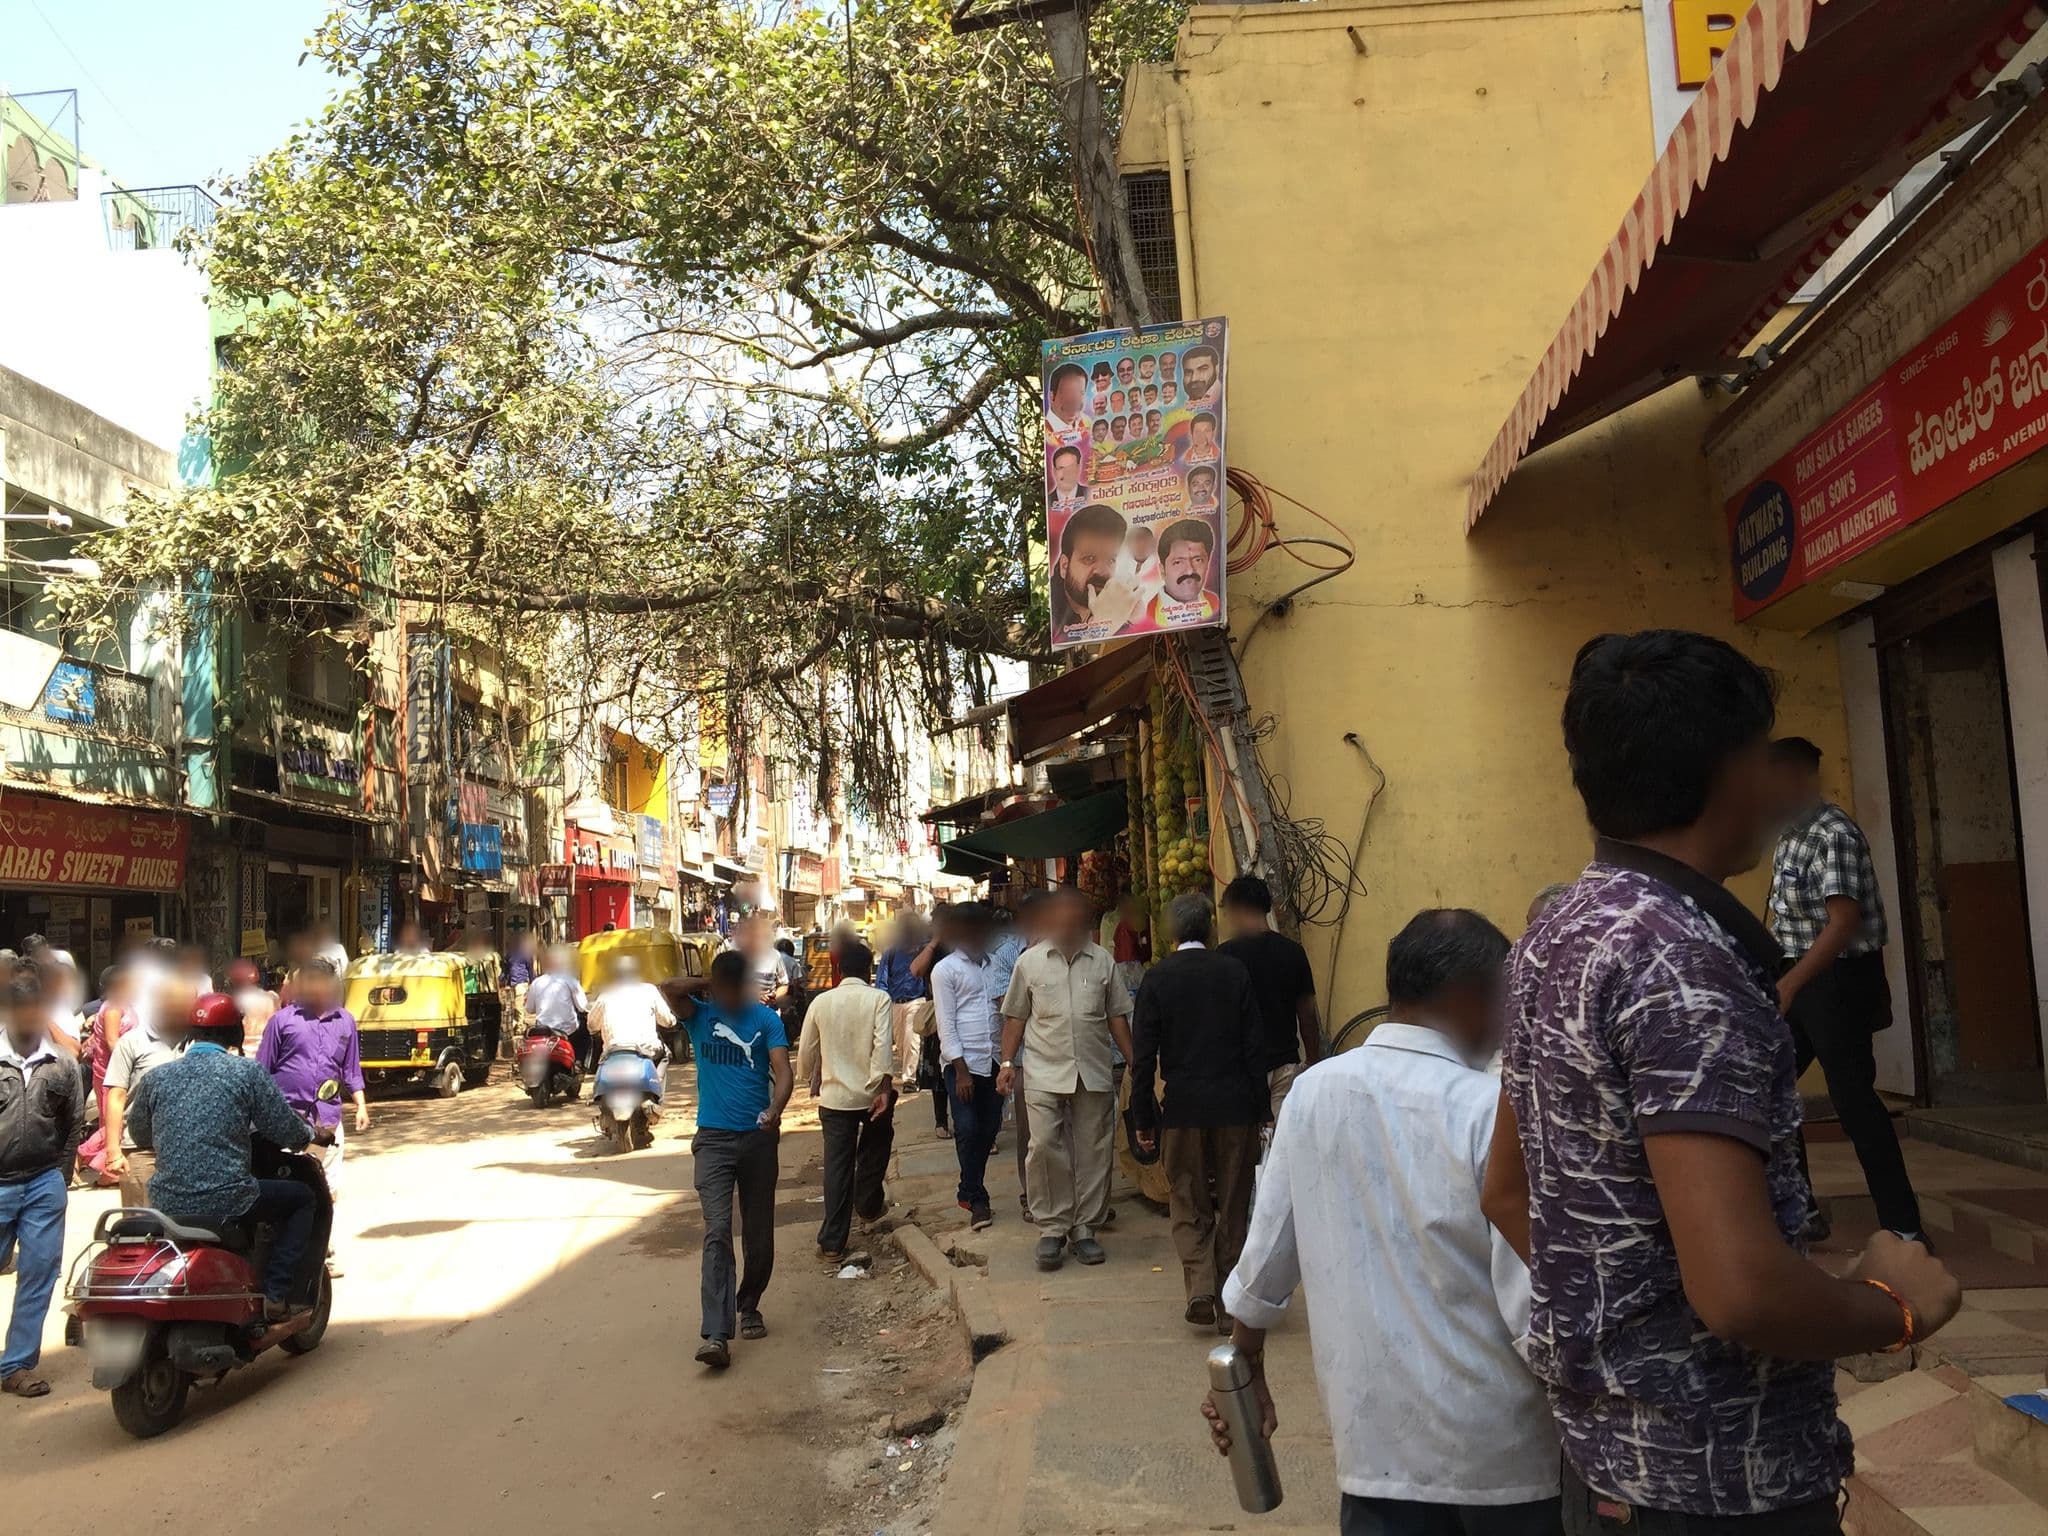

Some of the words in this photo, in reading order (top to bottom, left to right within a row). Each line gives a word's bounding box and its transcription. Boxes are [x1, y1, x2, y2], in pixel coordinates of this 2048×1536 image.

[1061, 337, 1117, 356] ಕರ್ನಾಟಕ
[1796, 455, 1816, 485] PARI
[1816, 439, 1838, 469] SILK
[1837, 430, 1846, 453] &
[1846, 399, 1883, 447] SAREES
[1092, 483, 1124, 501] ಮಕರ
[1800, 494, 1826, 528] RATHI
[1828, 470, 1856, 508] SON'S
[1804, 524, 1840, 568] NAKODA
[1840, 490, 1898, 543] MARKETING
[1741, 535, 1788, 587] BUILDING
[60, 850, 125, 885] SWEET
[127, 857, 178, 888] HOUSE
[543, 868, 567, 882] ATM
